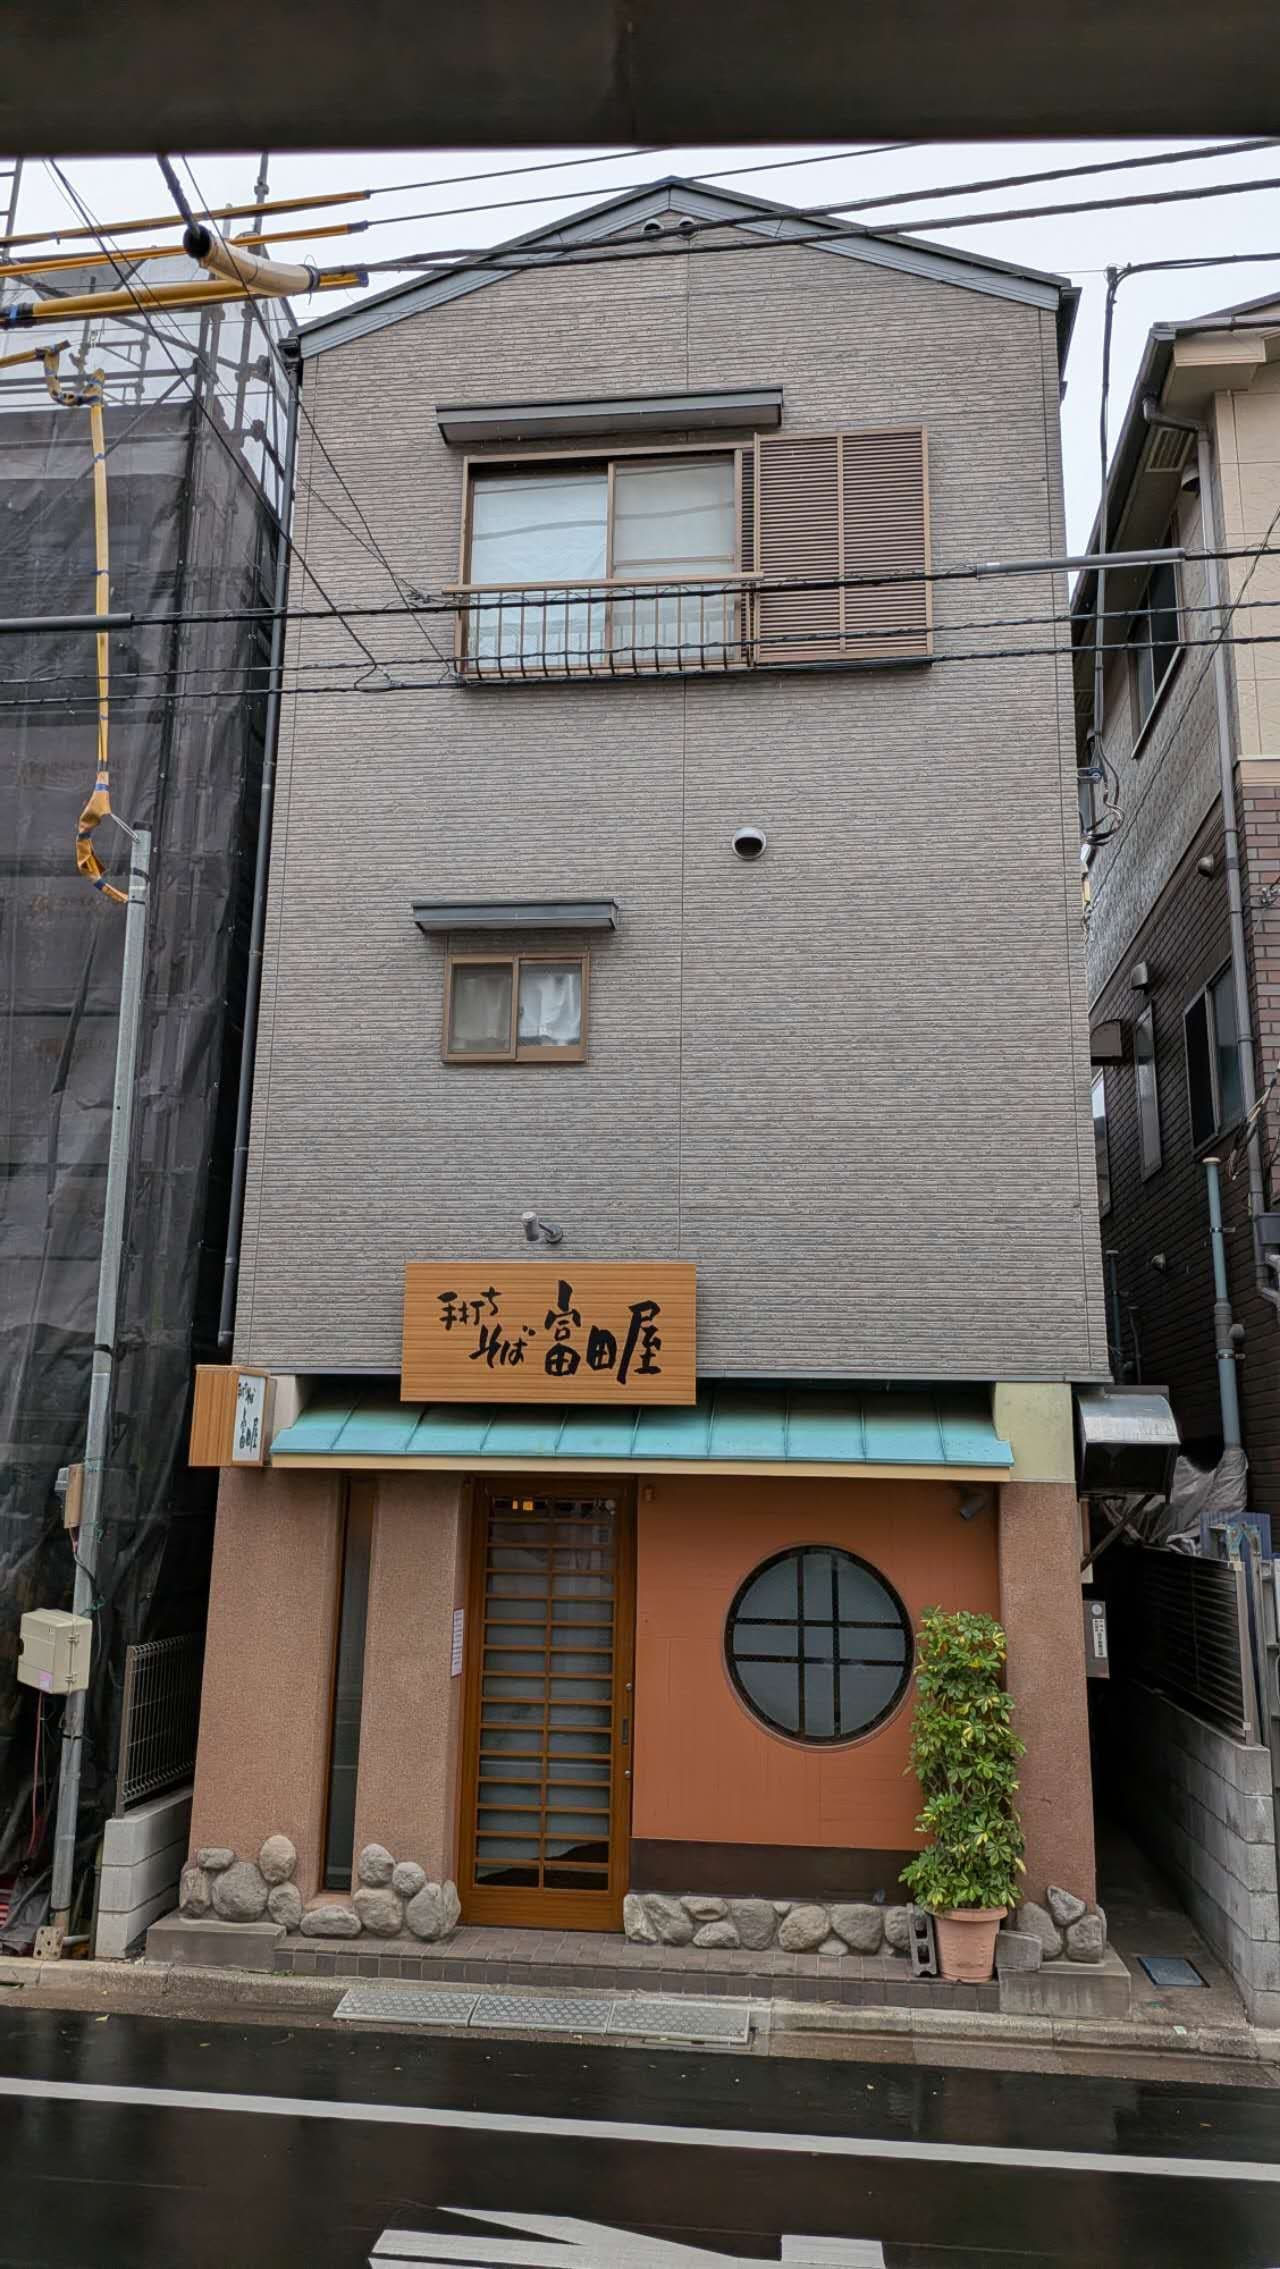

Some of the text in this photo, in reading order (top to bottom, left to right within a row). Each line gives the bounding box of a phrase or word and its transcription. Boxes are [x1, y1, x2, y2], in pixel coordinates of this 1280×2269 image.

[437, 1286, 502, 1331] 手打ち
[468, 1323, 536, 1369] そば
[544, 1279, 662, 1385] 富田屋
